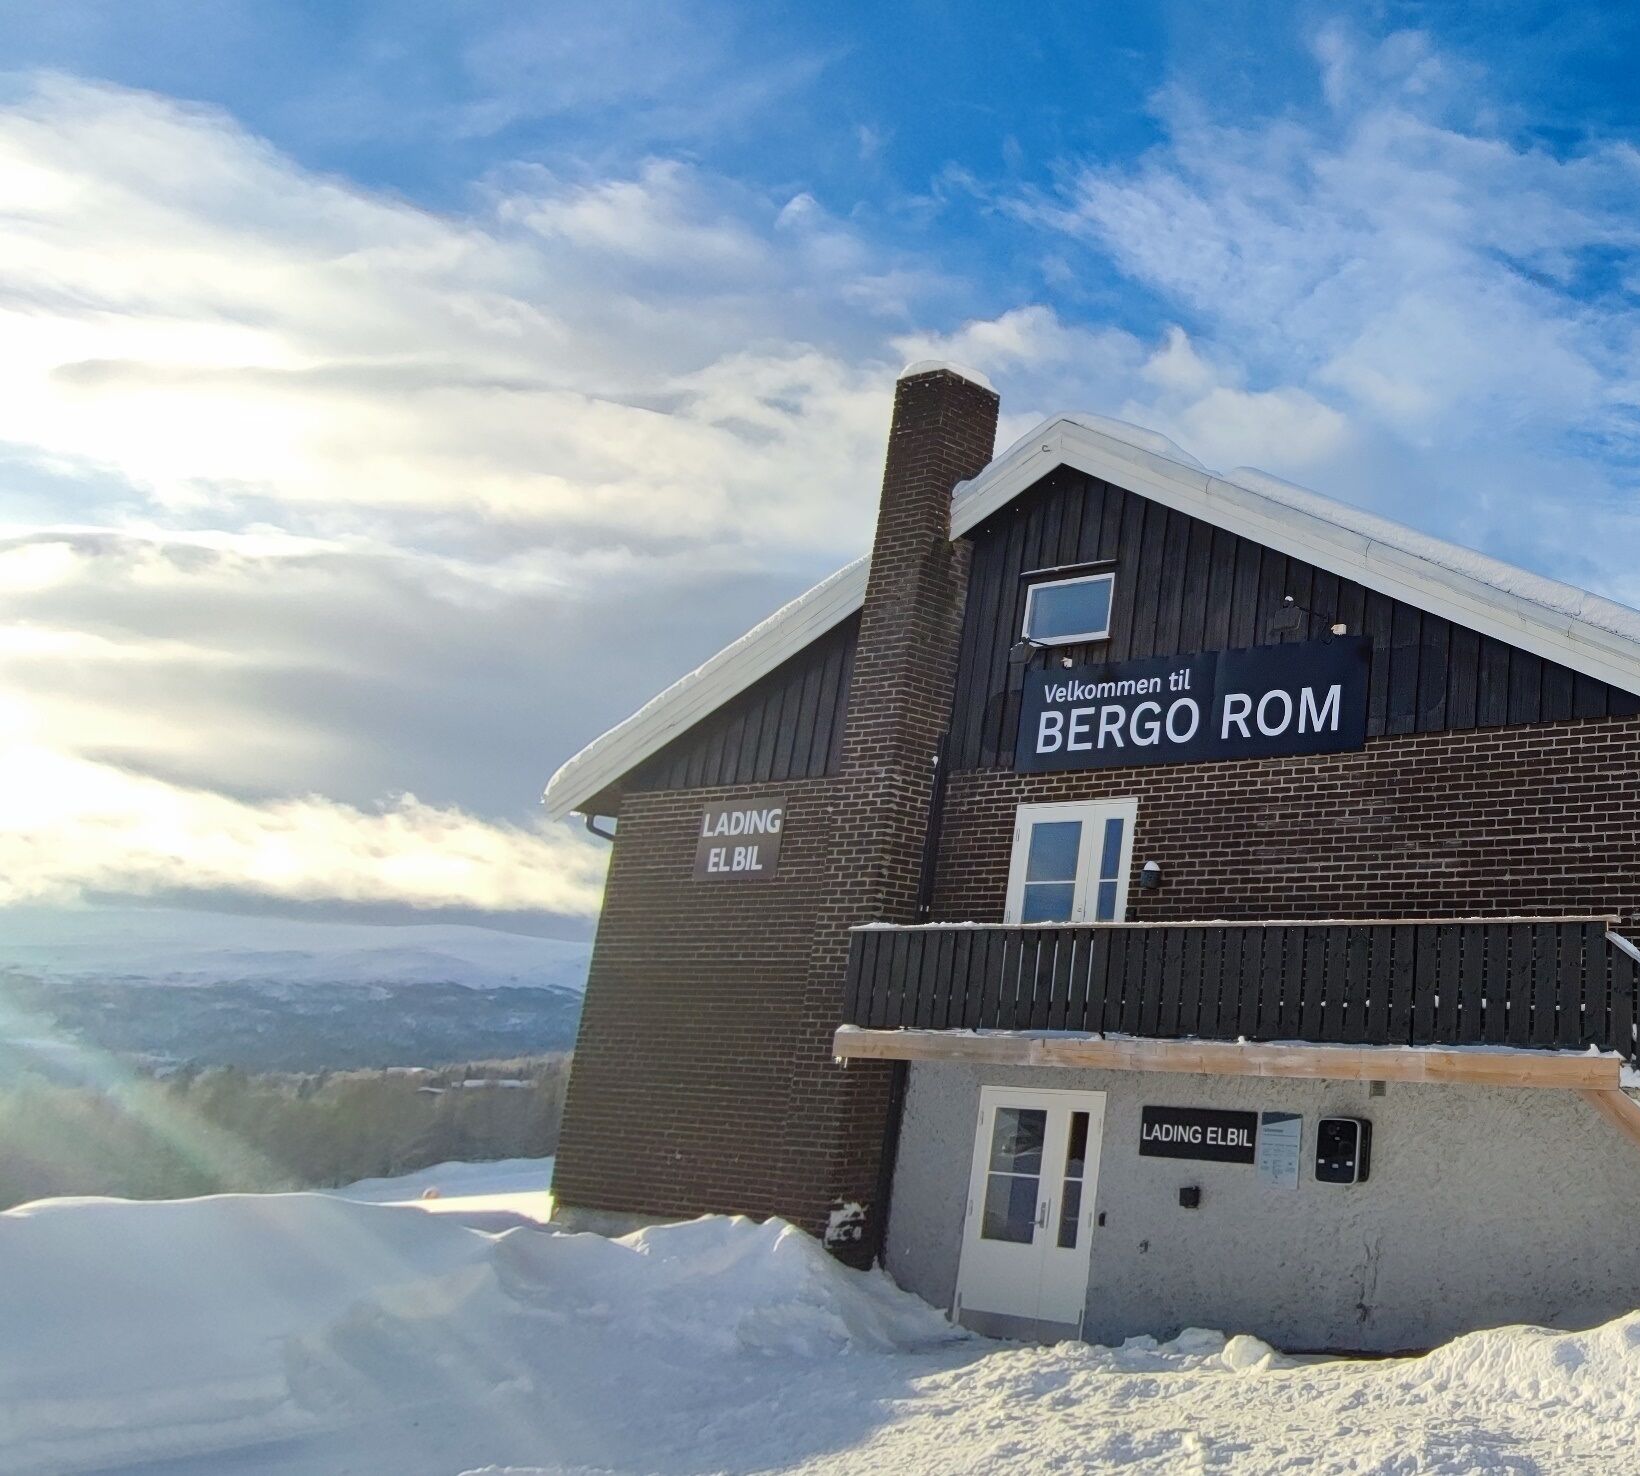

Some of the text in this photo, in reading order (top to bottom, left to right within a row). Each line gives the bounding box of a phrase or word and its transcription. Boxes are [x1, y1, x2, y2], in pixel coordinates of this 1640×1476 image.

[1045, 668, 1191, 703] Velkommen til
[1035, 684, 1342, 754] BERGO ROM
[702, 808, 782, 837] LADING
[1143, 1124, 1252, 1147] LADING ELBIL
